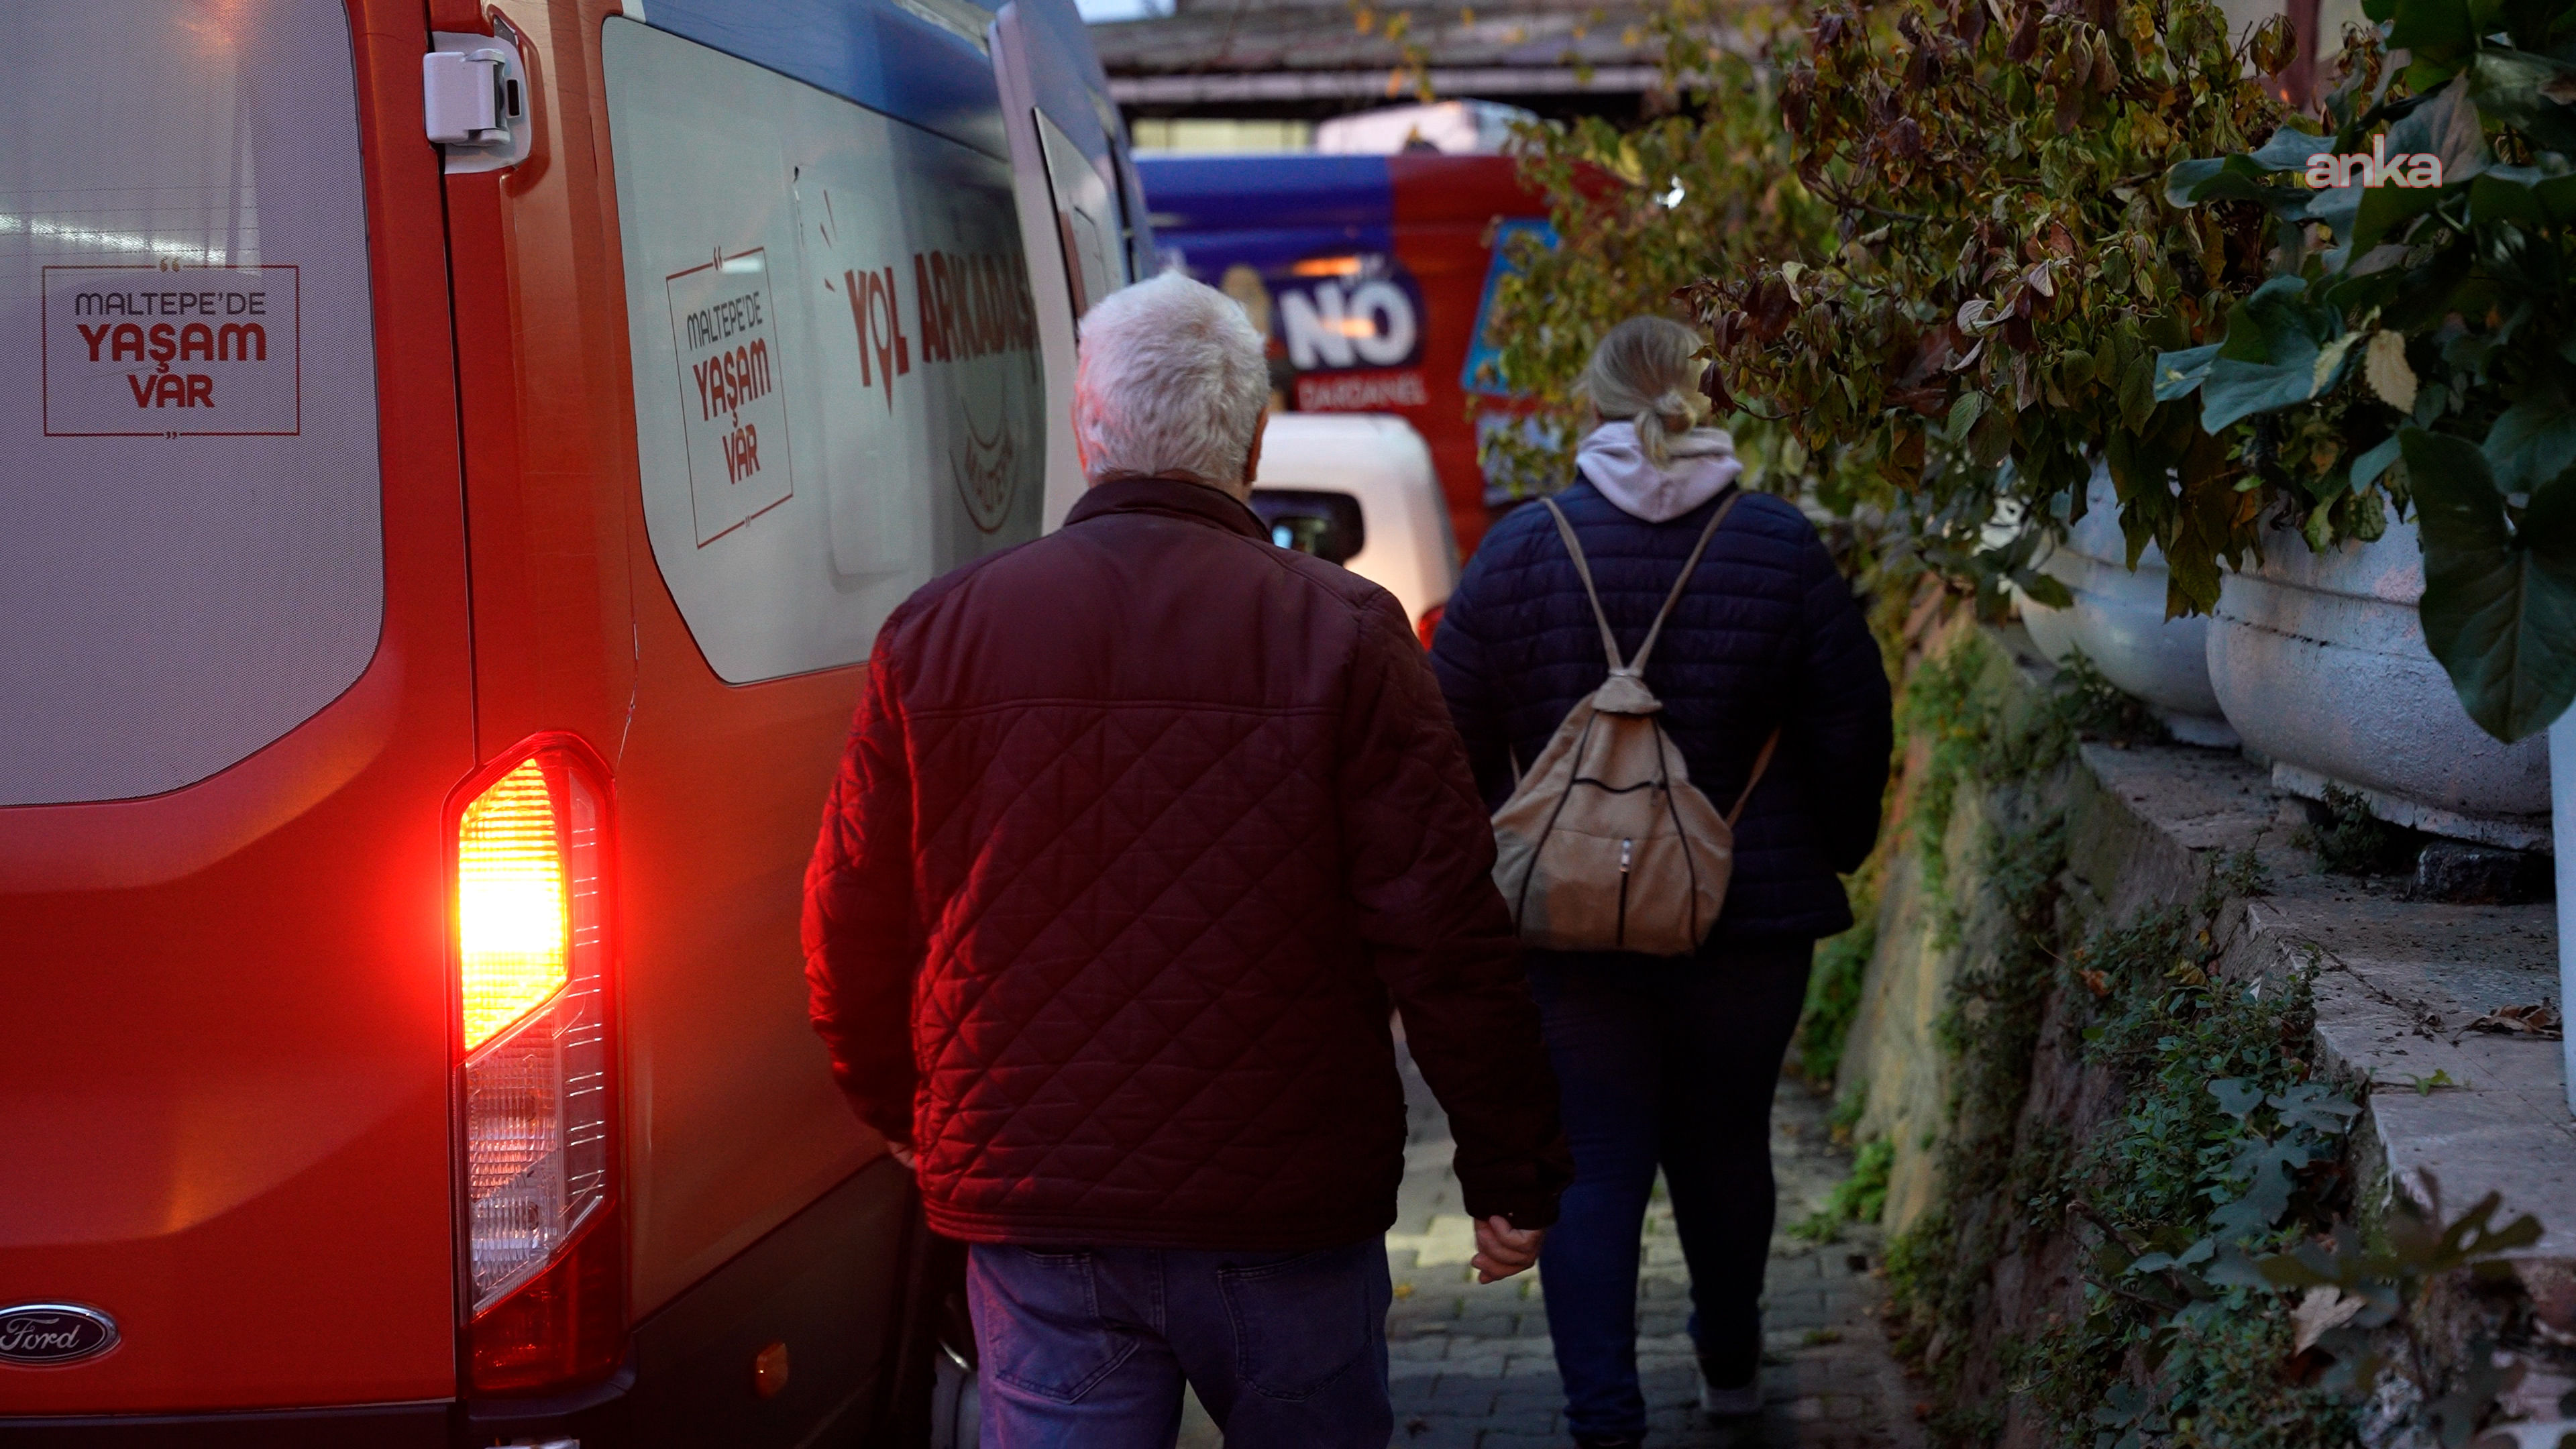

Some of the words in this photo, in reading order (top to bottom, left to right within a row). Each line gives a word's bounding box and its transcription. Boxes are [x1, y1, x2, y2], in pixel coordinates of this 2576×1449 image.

[75, 292, 266, 316] MALTEPE'DE
[686, 291, 763, 351] MALTEPE'DE
[1278, 279, 1416, 369] NO
[76, 323, 267, 373] YAŞAM
[844, 266, 910, 417] YOL
[127, 374, 215, 409] VAR
[692, 337, 771, 428] YAŞAM
[722, 423, 761, 484] VAR
[0, 1317, 81, 1351] Ford
